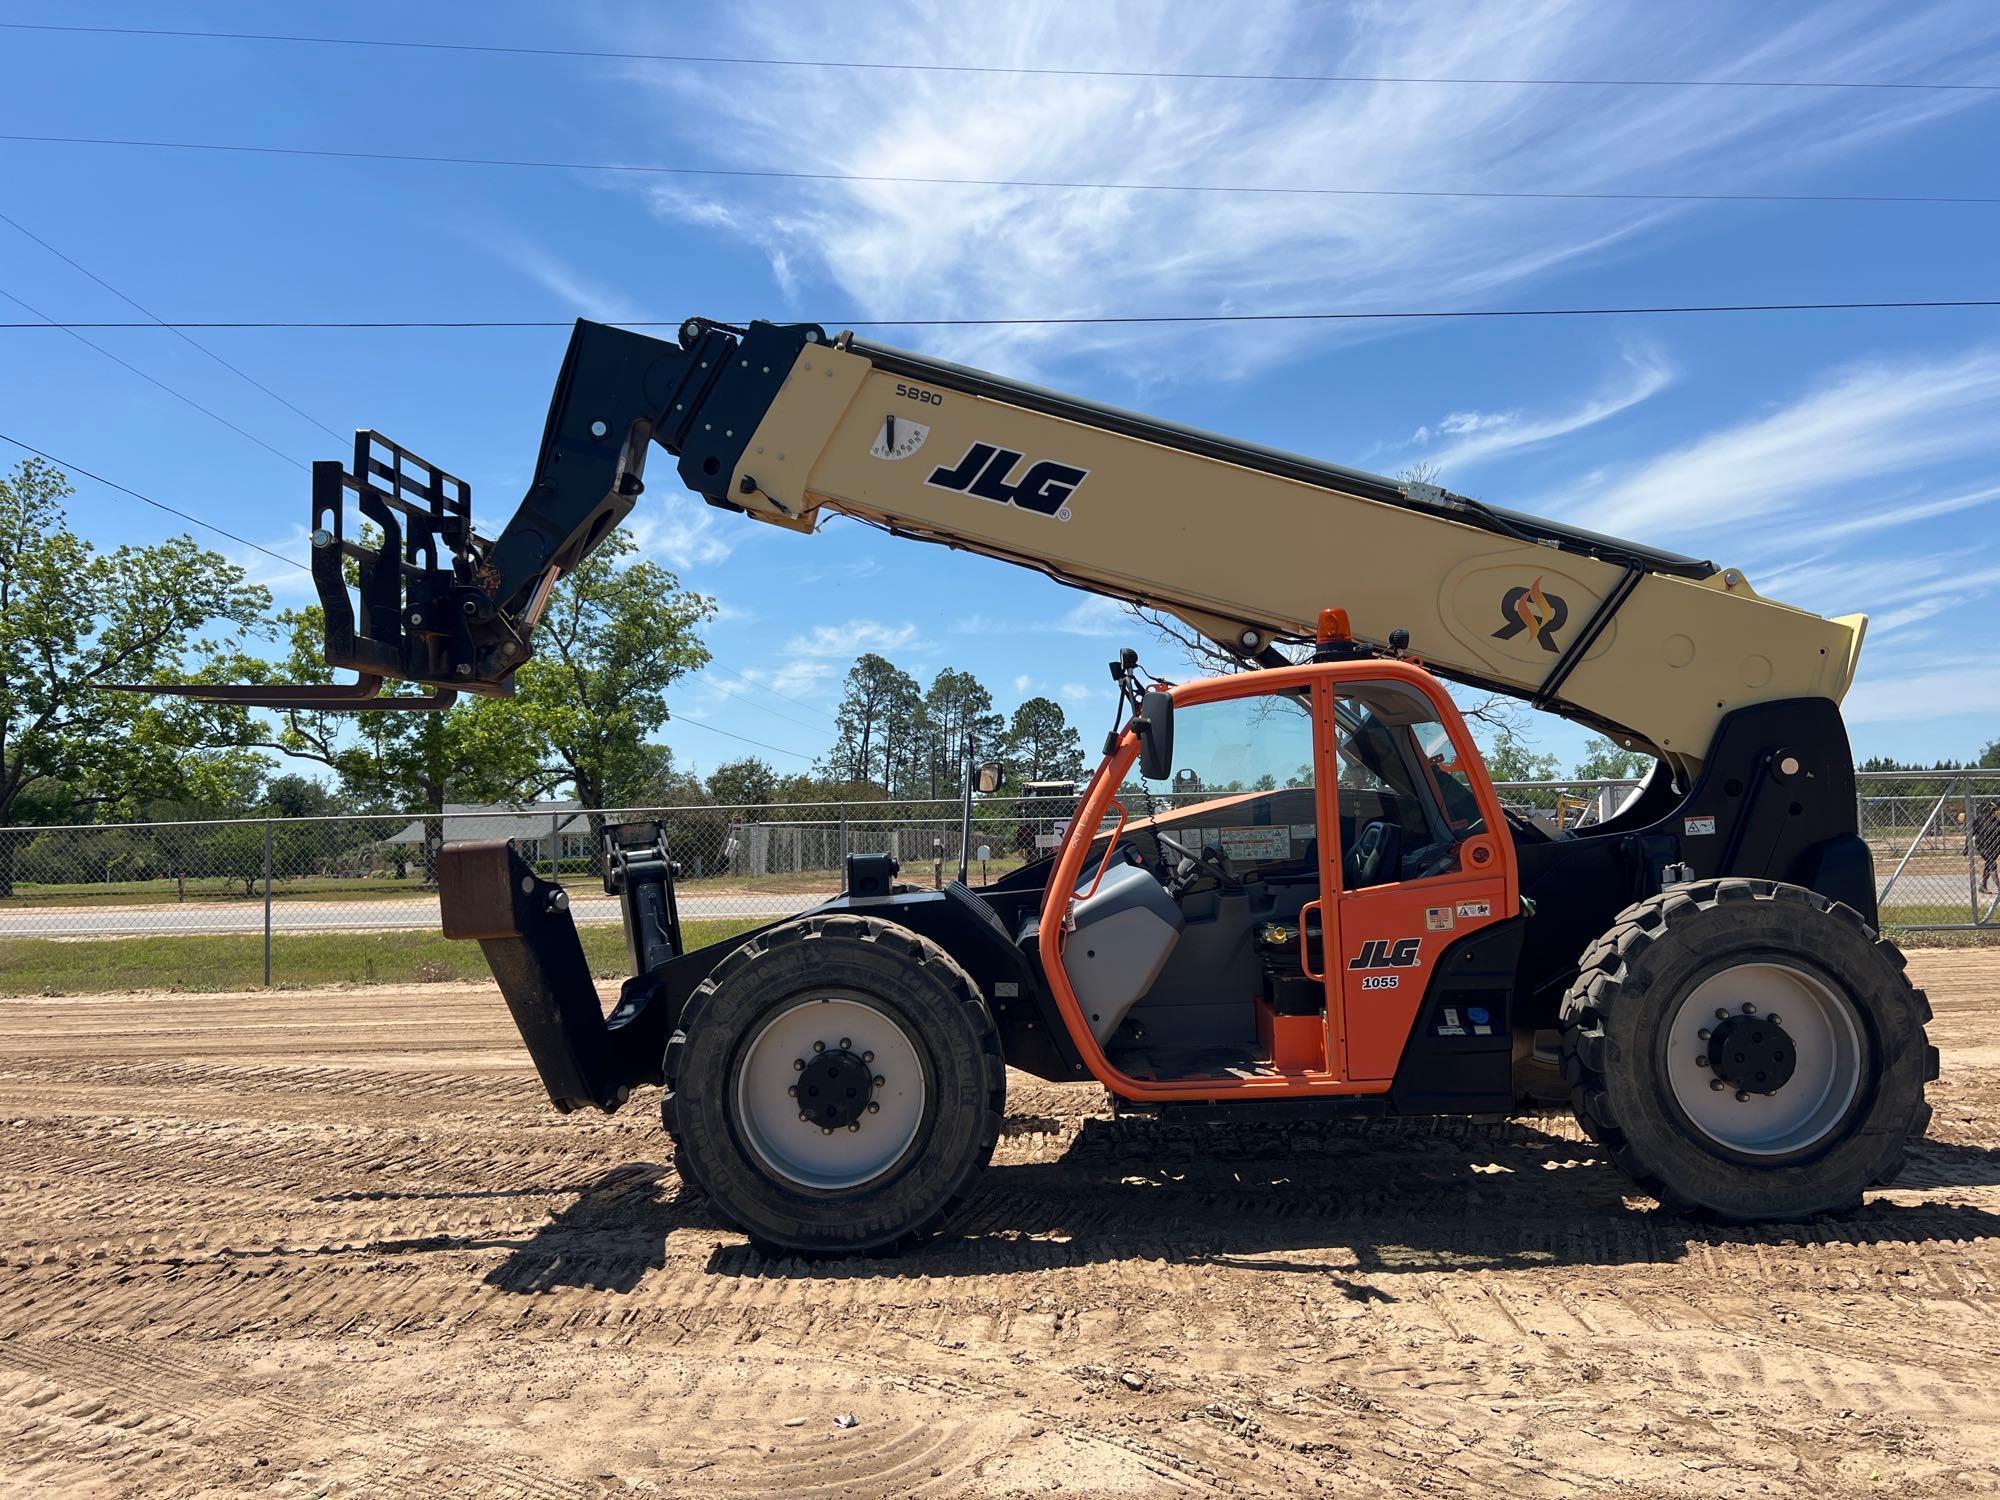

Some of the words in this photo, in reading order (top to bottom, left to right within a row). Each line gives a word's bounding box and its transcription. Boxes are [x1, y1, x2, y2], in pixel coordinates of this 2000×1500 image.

[895, 383, 943, 406] 5890
[924, 440, 1090, 518] JLG
[1347, 937, 1422, 971] JLG
[1362, 975, 1399, 990] 1055
